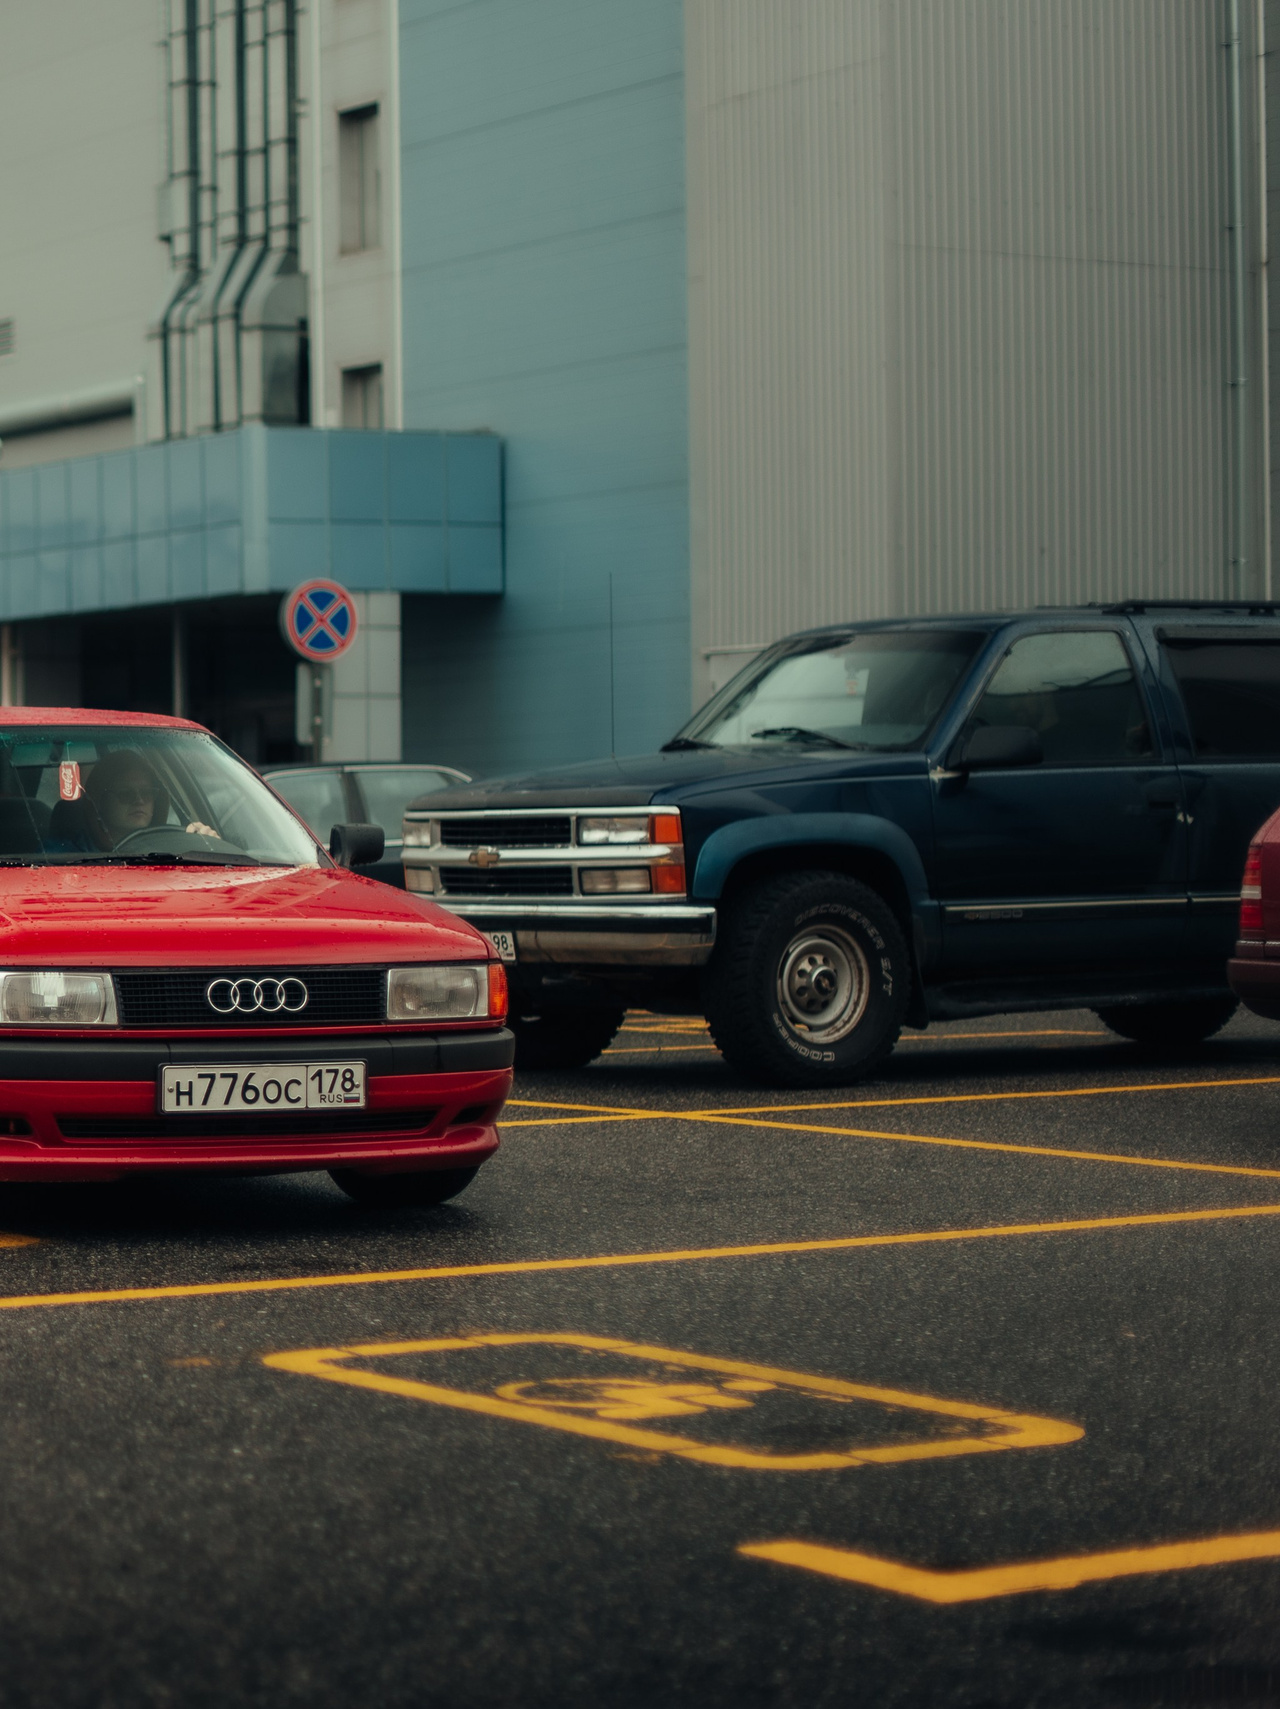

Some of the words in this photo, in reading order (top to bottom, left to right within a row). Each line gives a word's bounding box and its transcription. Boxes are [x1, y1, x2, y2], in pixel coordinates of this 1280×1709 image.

[794, 903, 886, 950] DISCOVERER
[881, 957, 893, 997] S/T
[772, 1012, 836, 1062] COOPER
[310, 1067, 355, 1094] 178
[320, 1093, 343, 1104] RUS
